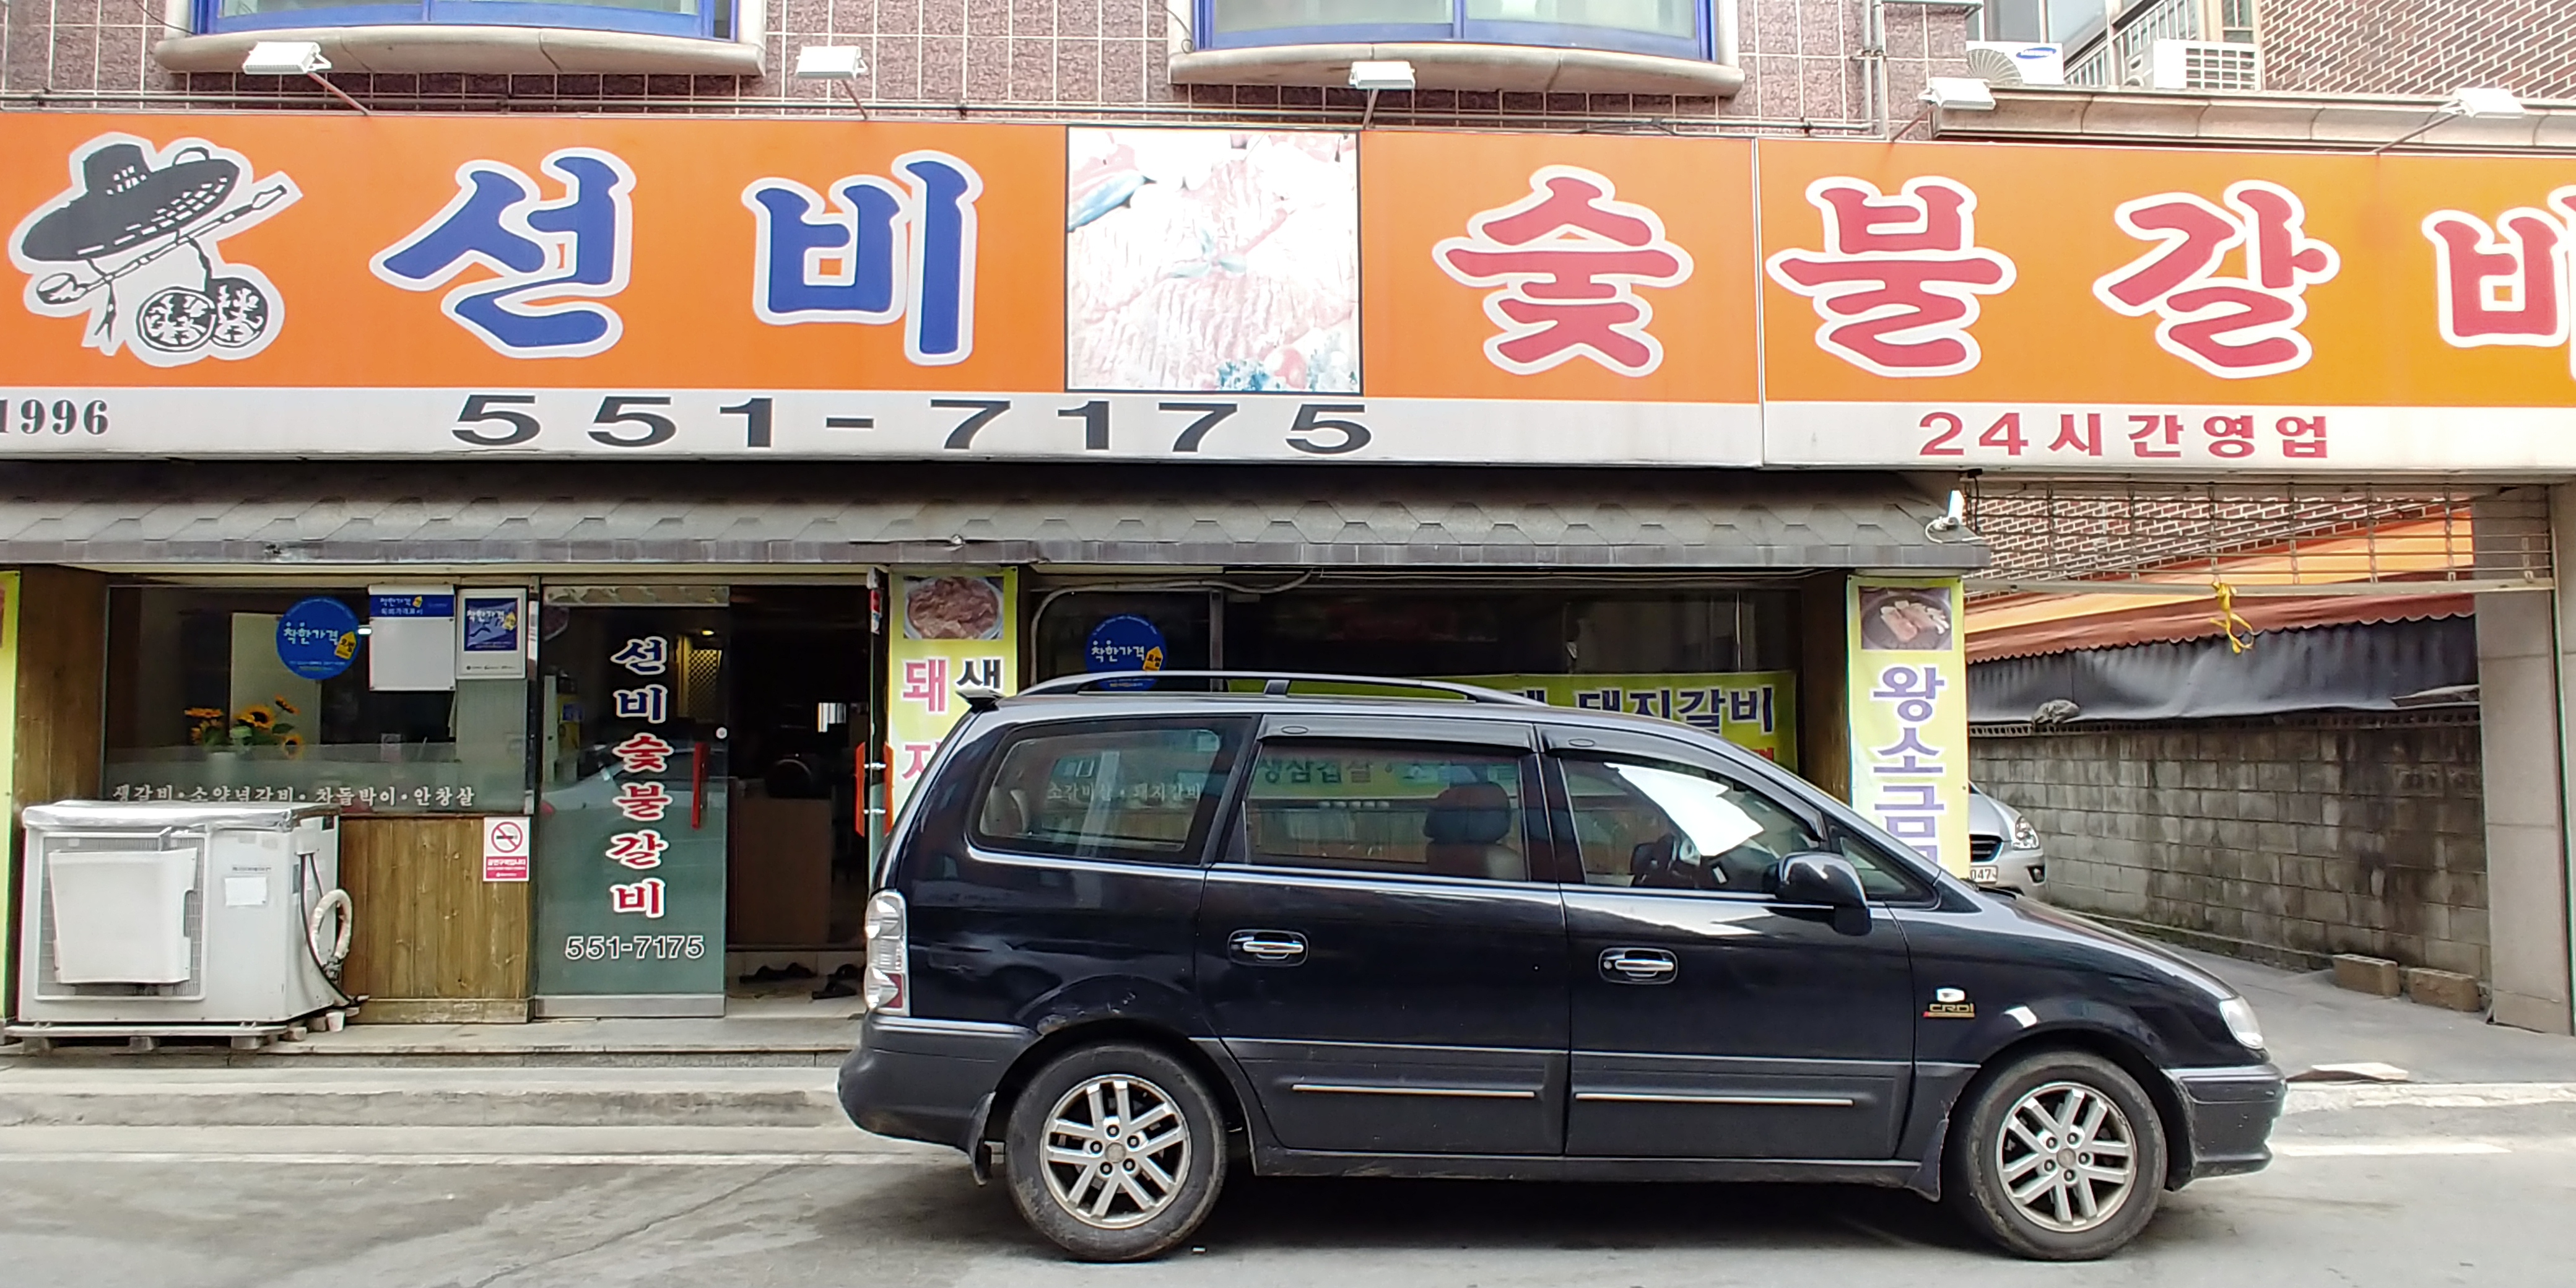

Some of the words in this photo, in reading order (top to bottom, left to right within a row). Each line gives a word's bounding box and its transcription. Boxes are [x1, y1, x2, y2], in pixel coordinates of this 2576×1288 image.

[0, 398, 109, 436] 1996
[451, 394, 1373, 454] 551-7175
[1918, 411, 2328, 459] 24시간영업
[283, 621, 339, 645] 착한가격
[1091, 640, 1145, 663] 착한가격
[564, 935, 705, 960] 551-7175
